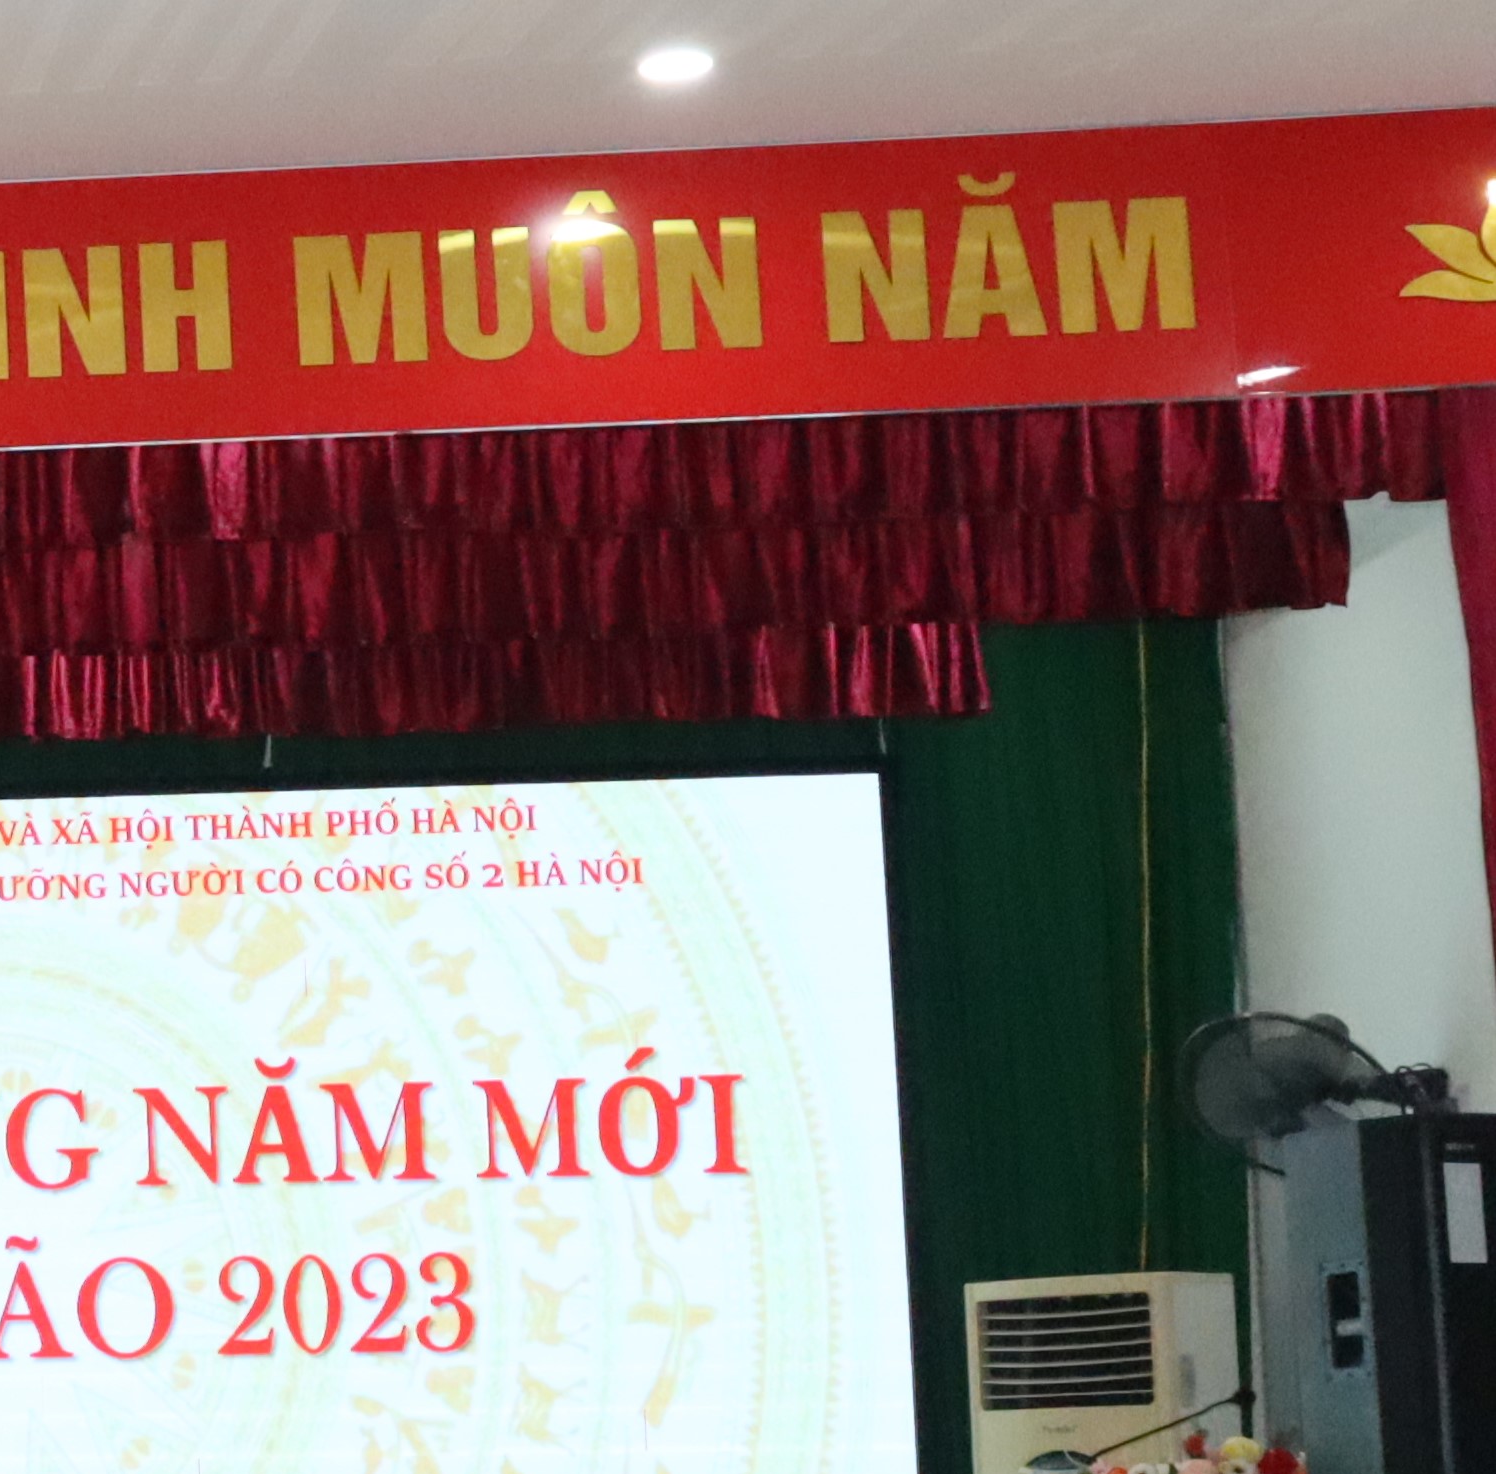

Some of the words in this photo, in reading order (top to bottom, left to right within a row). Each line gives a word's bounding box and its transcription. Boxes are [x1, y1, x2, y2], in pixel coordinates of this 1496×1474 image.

[294, 190, 762, 365] MUÔN
[822, 175, 1194, 342] NĂM
[51, 810, 97, 846] XÃ
[110, 808, 175, 850] HỘI
[185, 805, 312, 842] THÀNH
[326, 797, 399, 836] PHỐ
[411, 799, 461, 835] HÀ
[472, 797, 537, 840] NỘI
[118, 858, 246, 899] NGƯỜI
[256, 859, 303, 895] CÓ
[313, 856, 412, 892] CÔNG
[423, 850, 471, 890] SỐ
[481, 863, 505, 889] 2
[515, 852, 568, 889] HÀ
[578, 849, 644, 892] NỘI
[132, 1056, 438, 1188] NĂM
[472, 1046, 750, 1180] MỚI
[217, 1251, 477, 1357] 2023
